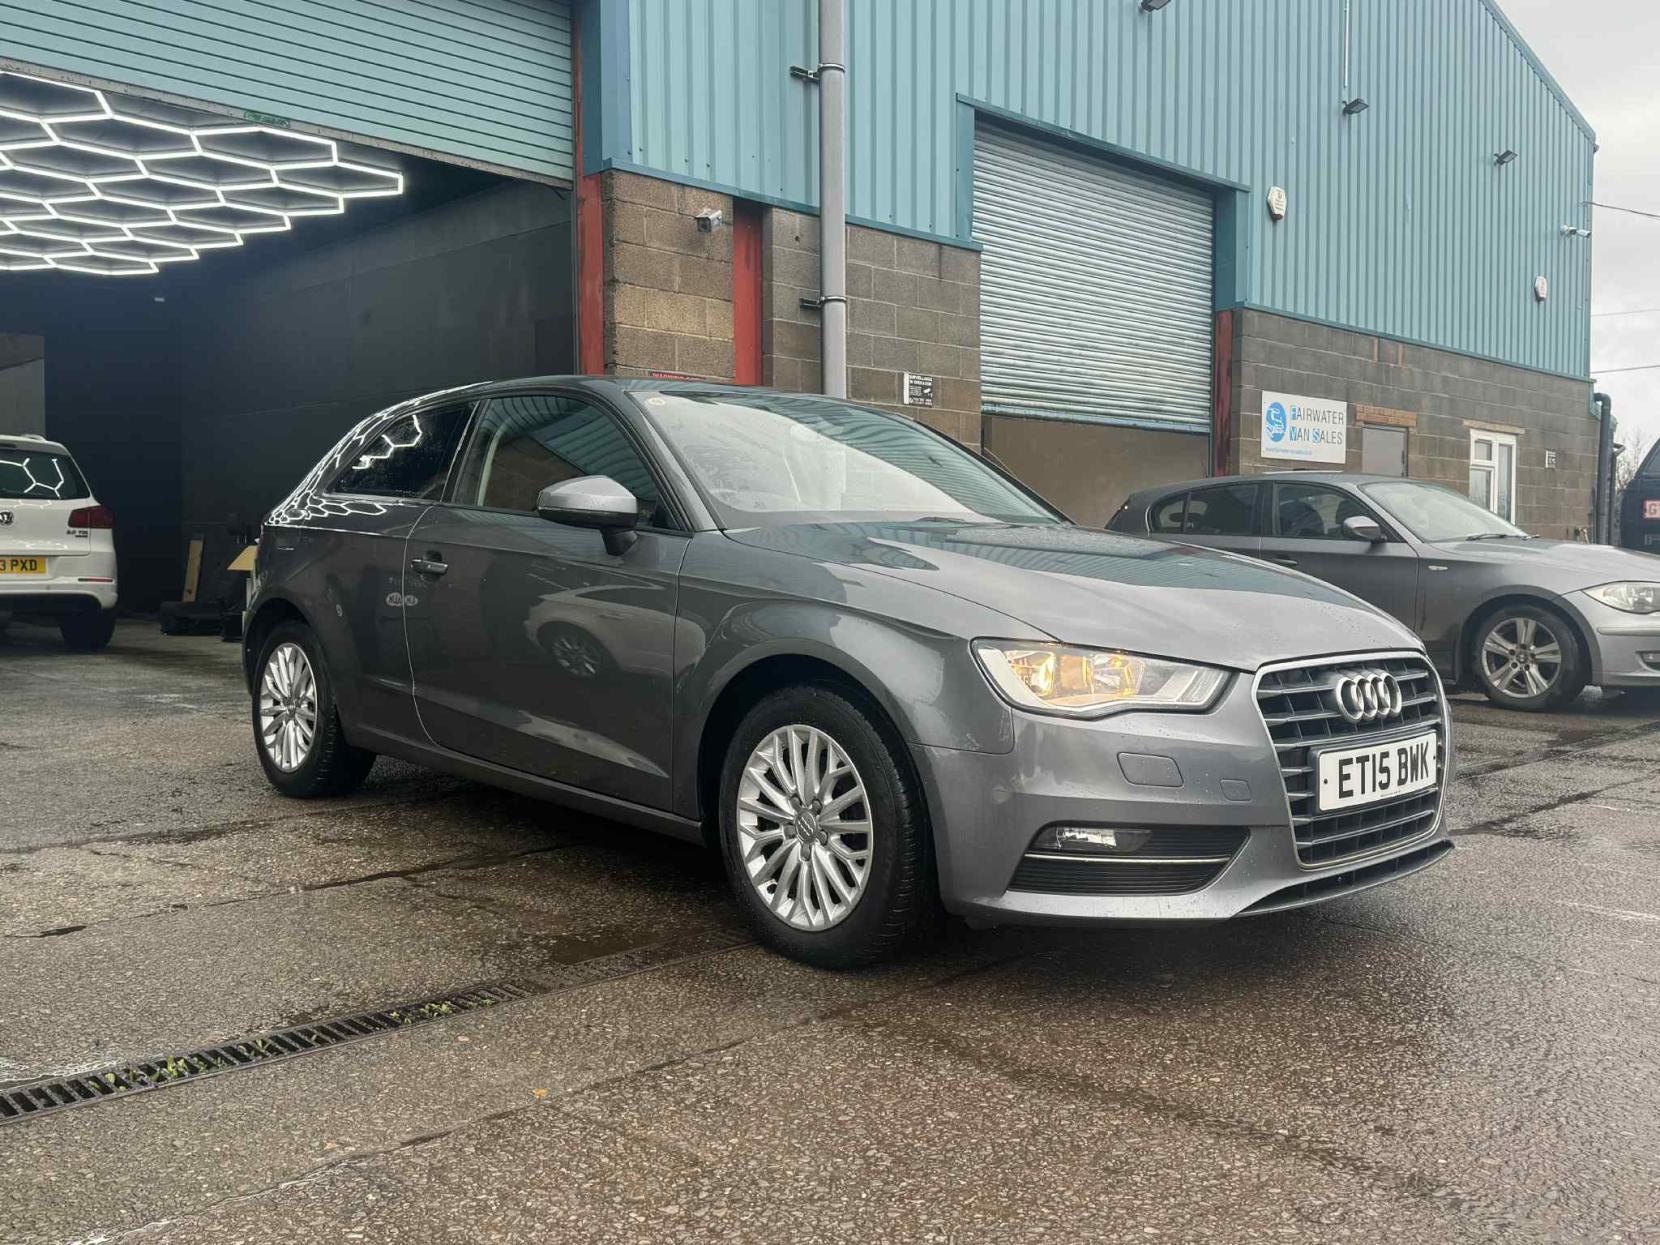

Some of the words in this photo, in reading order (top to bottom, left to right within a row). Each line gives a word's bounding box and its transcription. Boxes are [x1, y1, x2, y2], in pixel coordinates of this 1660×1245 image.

[1289, 404, 1344, 425] FAIRWATER
[1289, 426, 1310, 441] VAN
[1312, 428, 1343, 445] SALES
[10, 559, 38, 571] PXD
[1338, 751, 1391, 800] ET15
[1396, 741, 1429, 786] BWK
